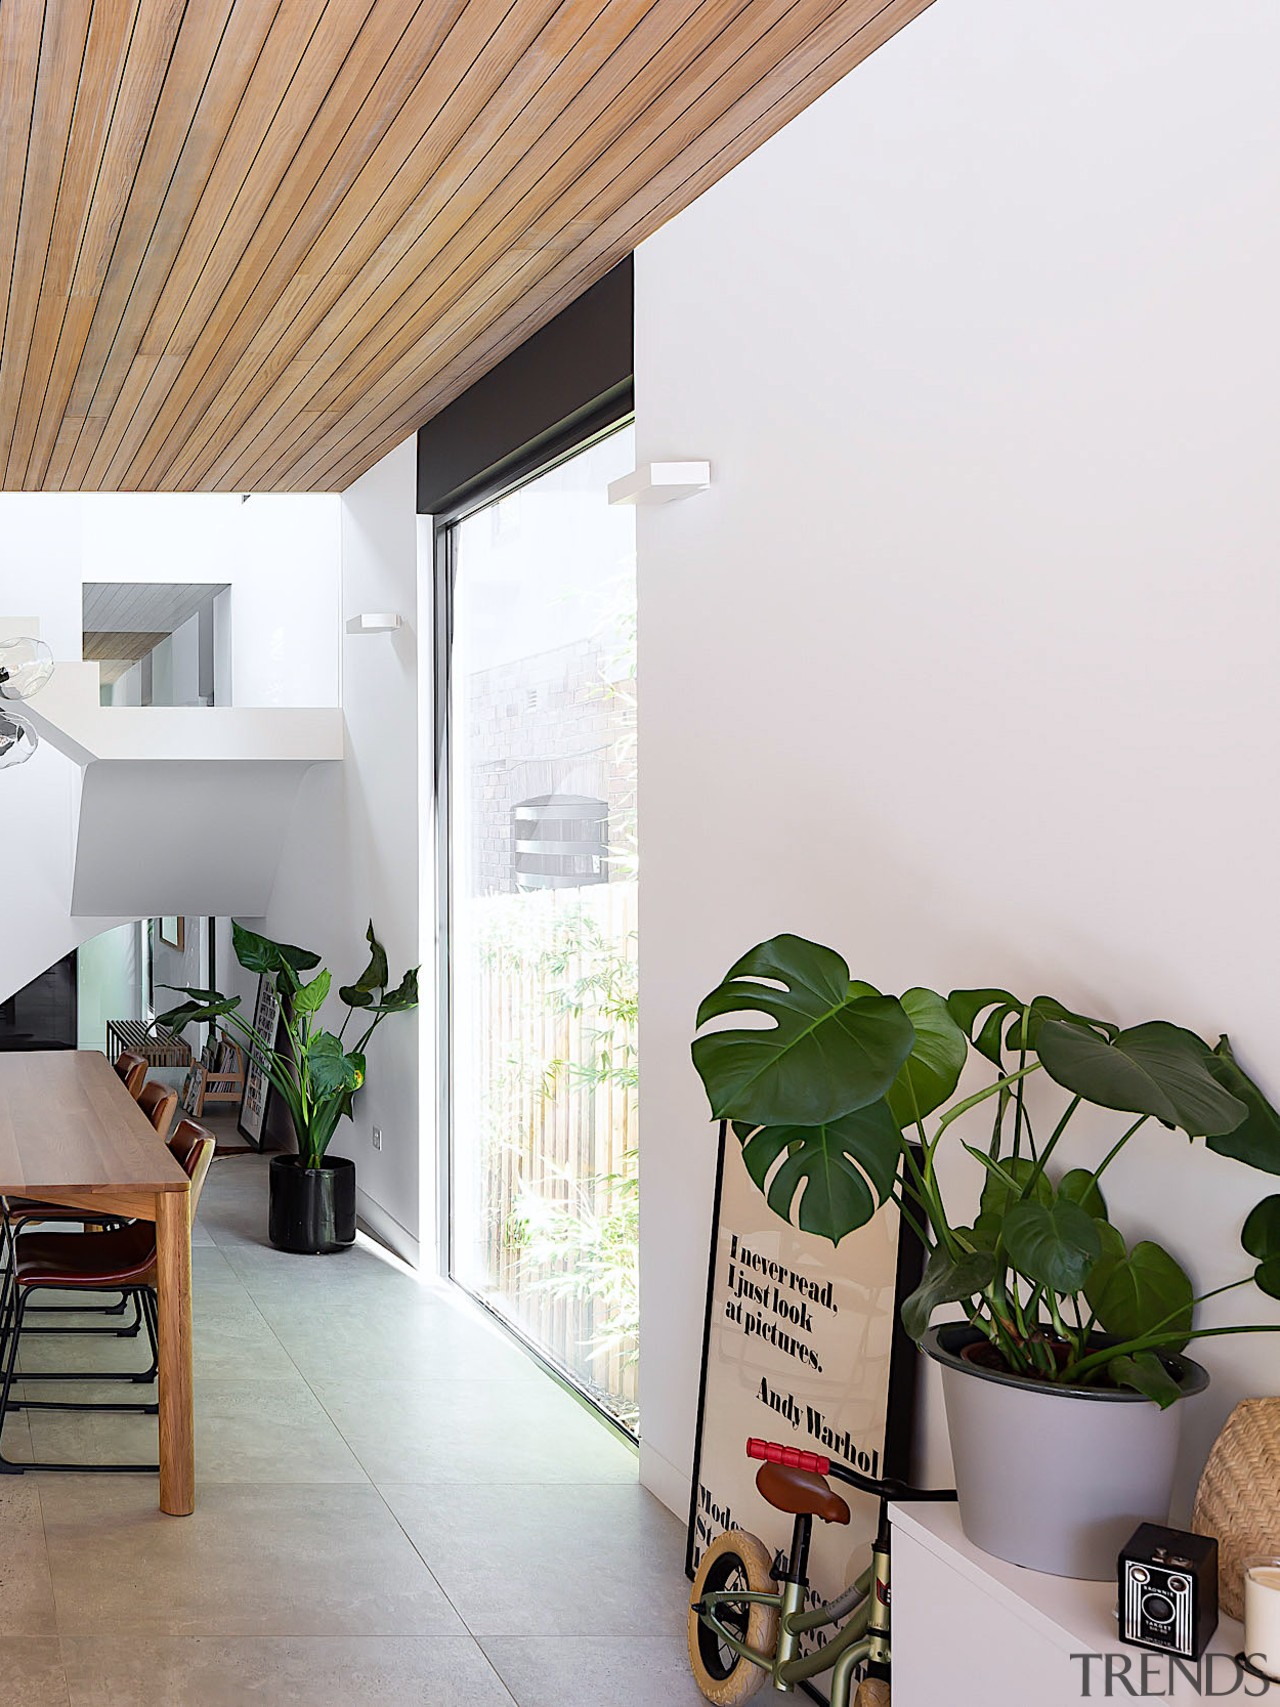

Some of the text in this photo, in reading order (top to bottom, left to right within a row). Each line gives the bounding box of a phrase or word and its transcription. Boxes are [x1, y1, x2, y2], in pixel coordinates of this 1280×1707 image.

[727, 1262, 814, 1334] I just look
[729, 1233, 839, 1319] I never read,
[724, 1300, 824, 1374] at pictures.
[755, 1375, 880, 1480] Andy Warhol
